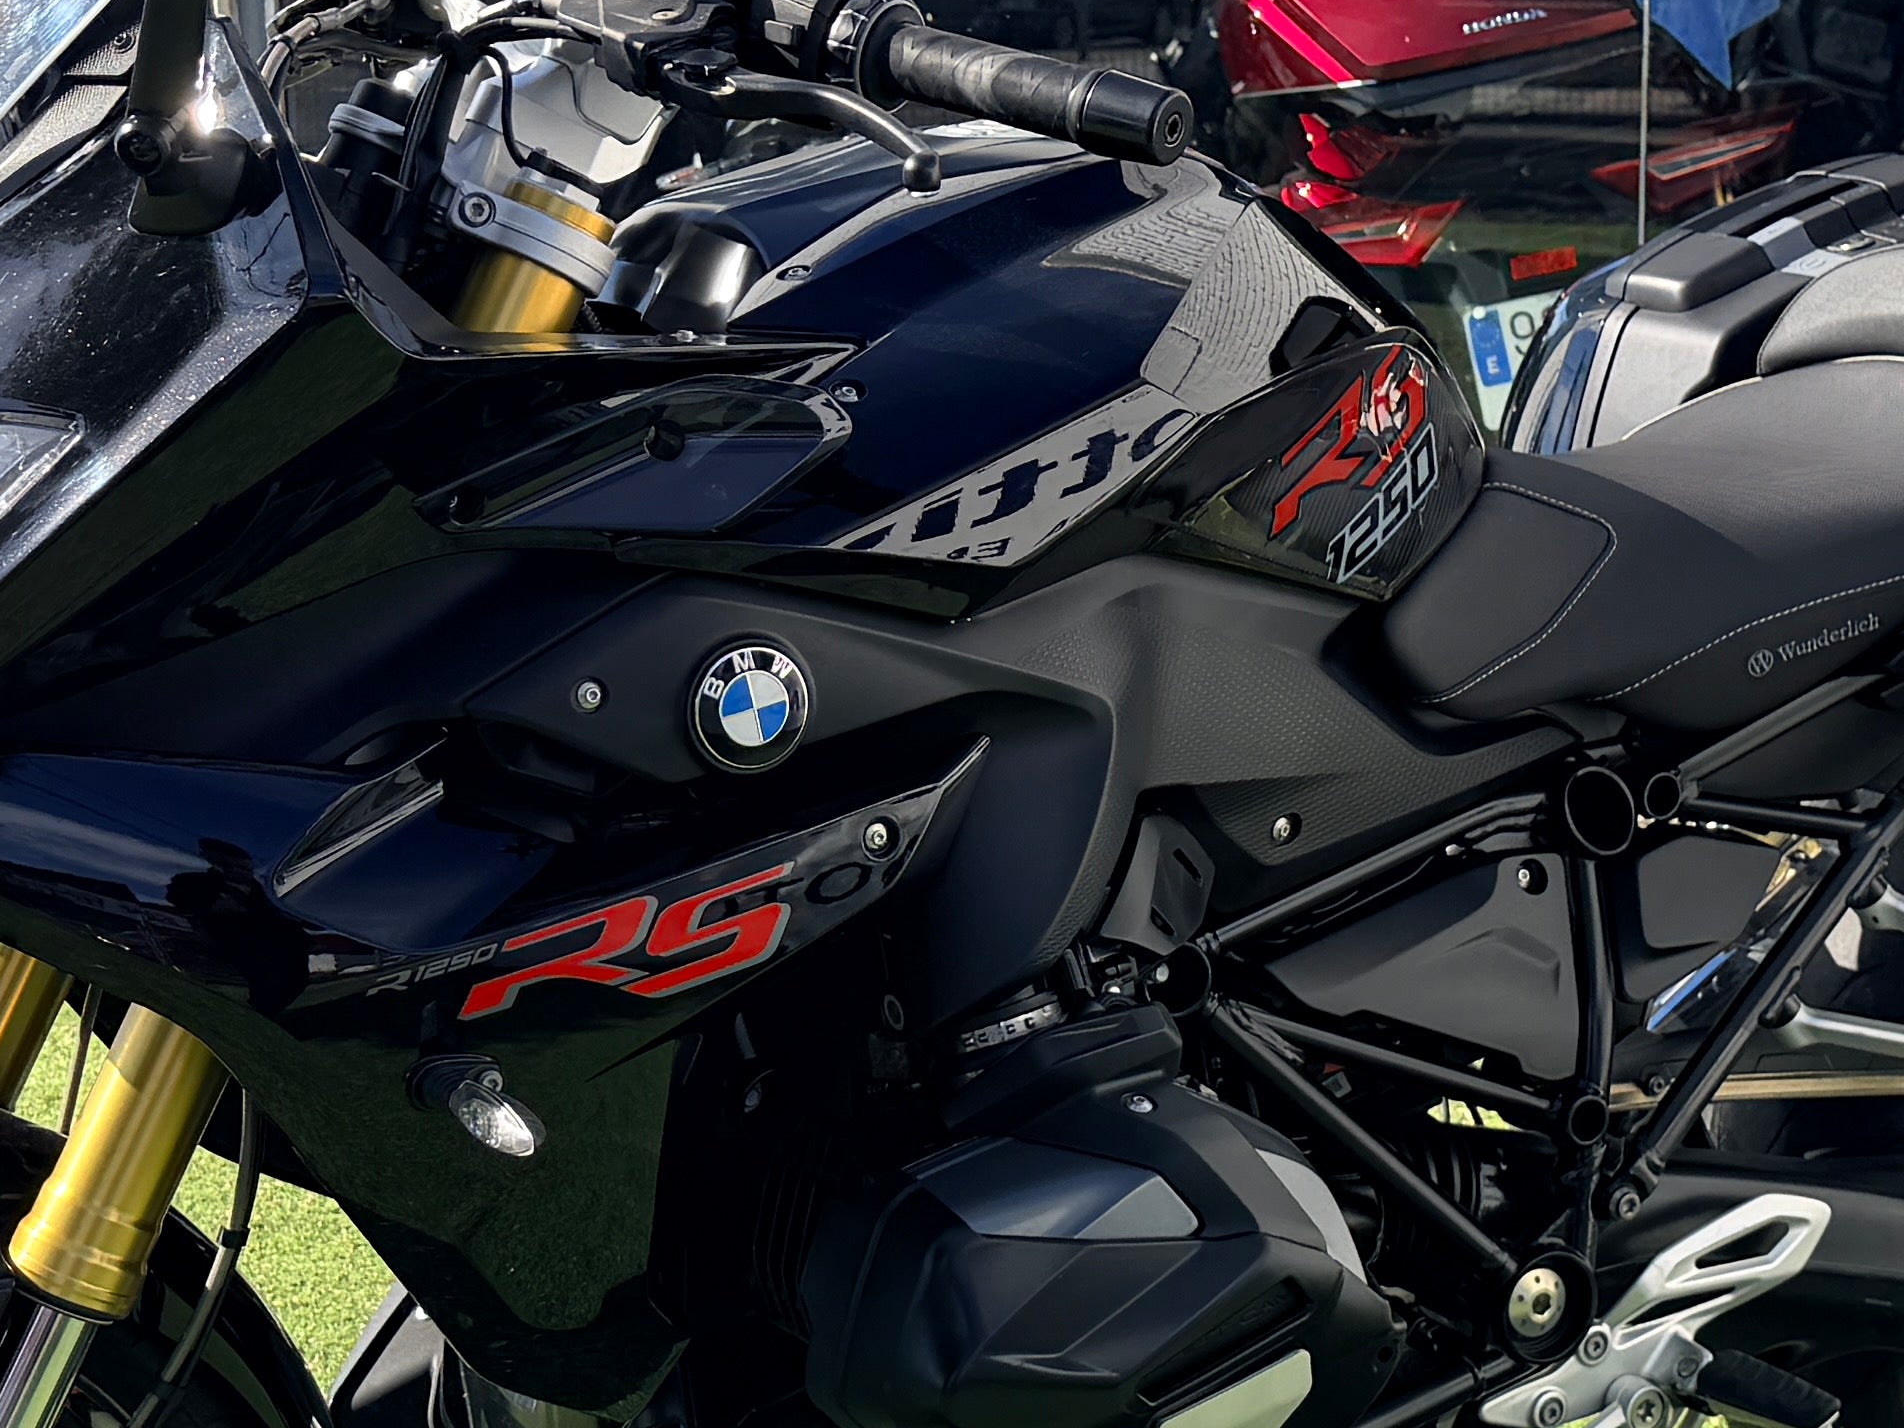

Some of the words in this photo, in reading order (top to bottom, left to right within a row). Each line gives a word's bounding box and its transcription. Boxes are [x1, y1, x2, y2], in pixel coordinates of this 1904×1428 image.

[1325, 422, 1439, 585] 1250
[703, 650, 794, 700] BMW
[1778, 613, 1880, 662] Wunderlich
[457, 861, 796, 1022] RS
